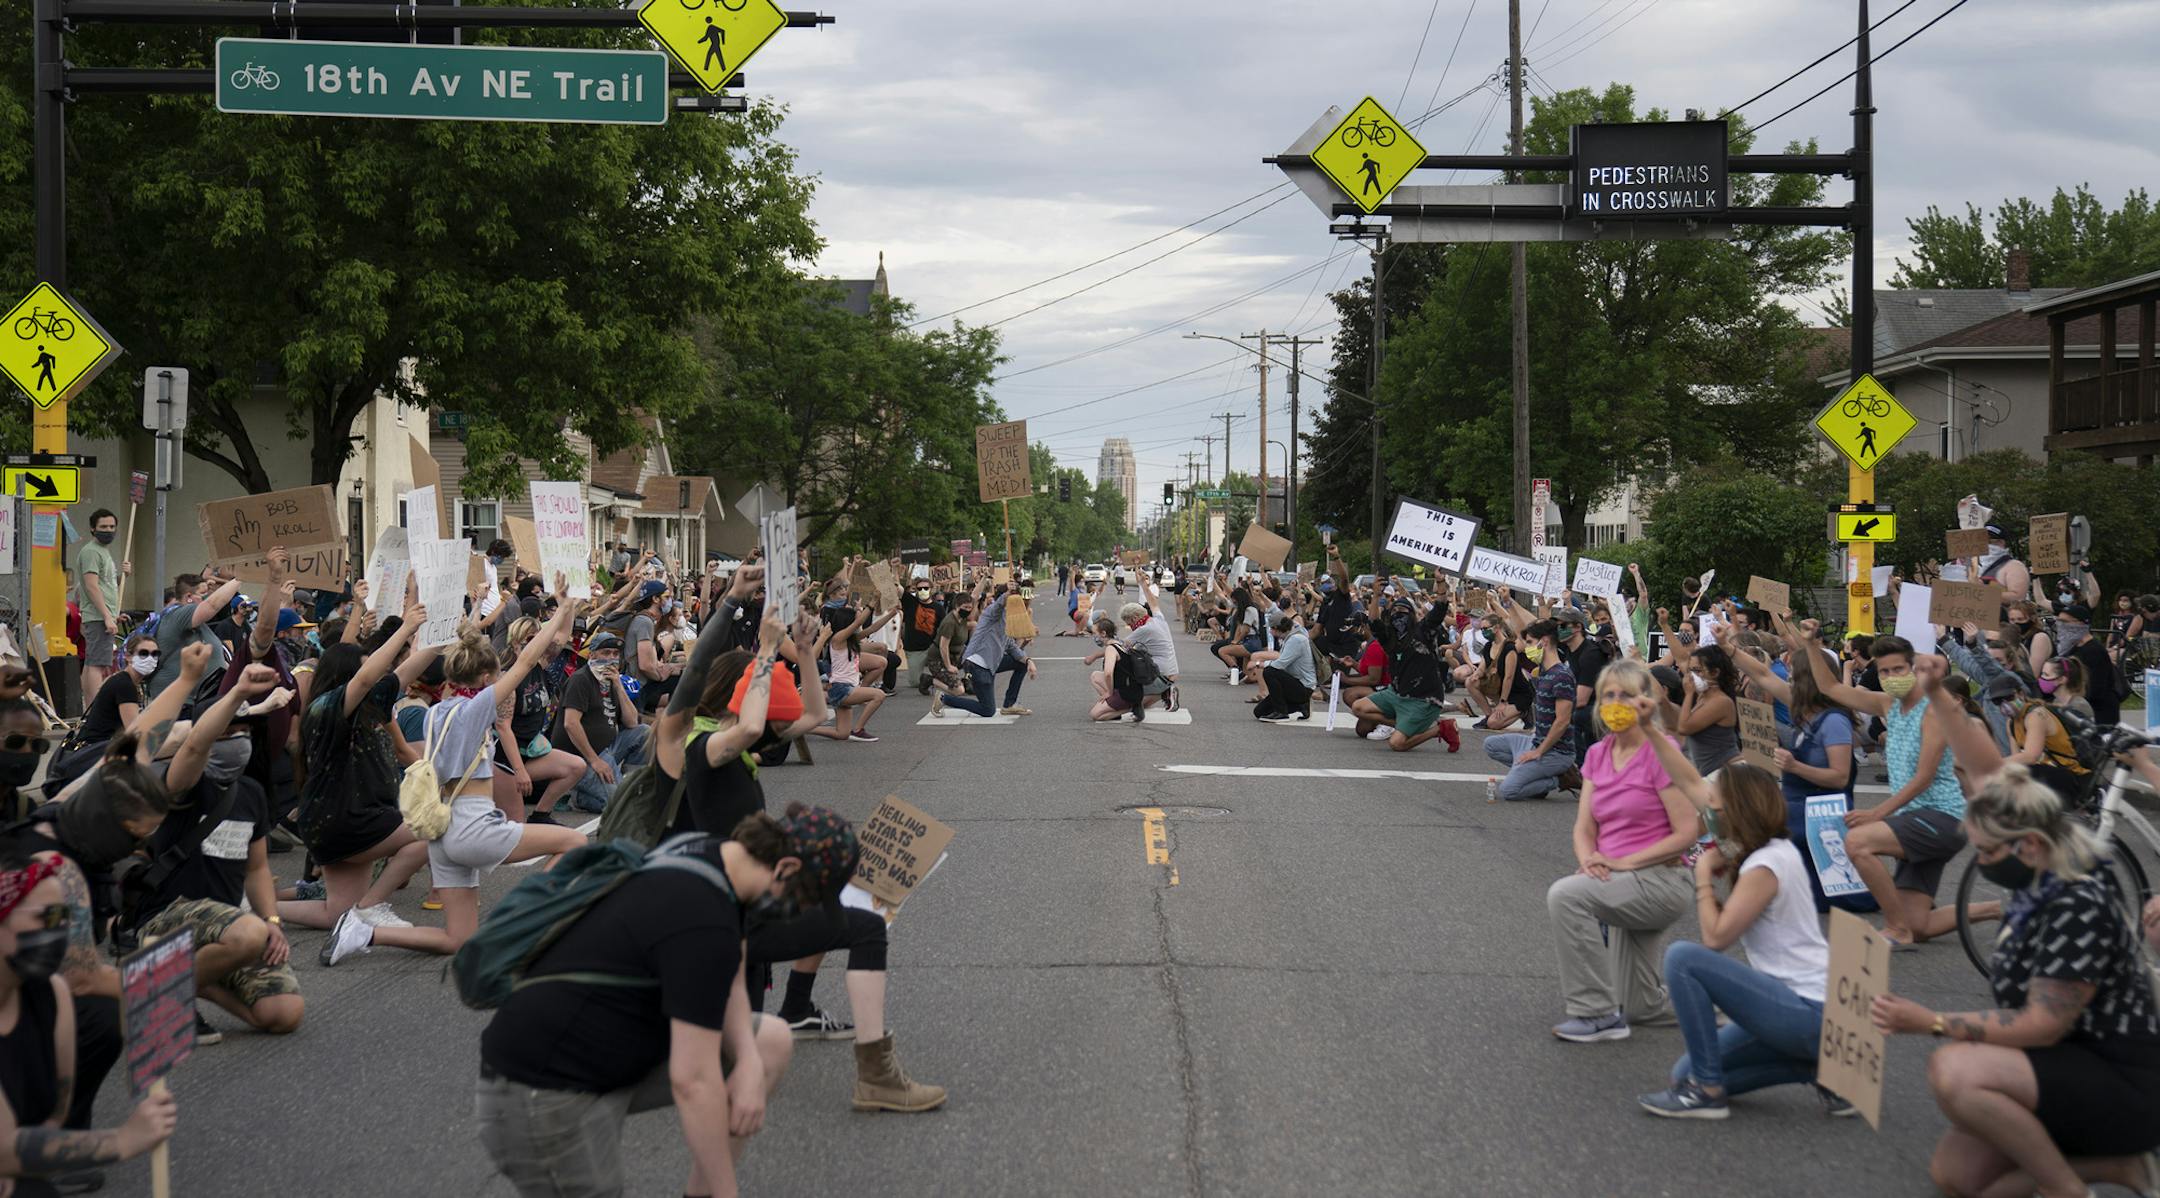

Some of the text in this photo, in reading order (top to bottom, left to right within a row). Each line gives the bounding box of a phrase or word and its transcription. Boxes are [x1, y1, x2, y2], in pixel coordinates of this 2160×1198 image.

[304, 63, 644, 103] 18th Av NE Trail
[1589, 165, 1710, 186] PEDESTRIANS
[1583, 190, 1717, 211] IN CROSSWALK
[445, 414, 456, 425] NE
[978, 425, 1020, 445] SWEEP
[980, 445, 1018, 460] UP THE
[981, 459, 1021, 477] TRASH
[265, 500, 298, 517] BOB
[1426, 510, 1454, 526] THIS
[272, 521, 321, 538] KROLL
[1443, 530, 1455, 541] IS
[1391, 534, 1458, 561] AMERIKKKA
[1472, 556, 1491, 572] NO
[1539, 553, 1563, 564] BLACK
[1579, 561, 1616, 581] Justice
[1944, 585, 1984, 601] JUSTICE
[1807, 802, 1843, 817] KROLL
[878, 803, 927, 837] HEALING
[868, 818, 913, 848] STARTS
[895, 848, 917, 868] THE
[888, 864, 918, 888] WAS
[1861, 934, 1873, 976] I
